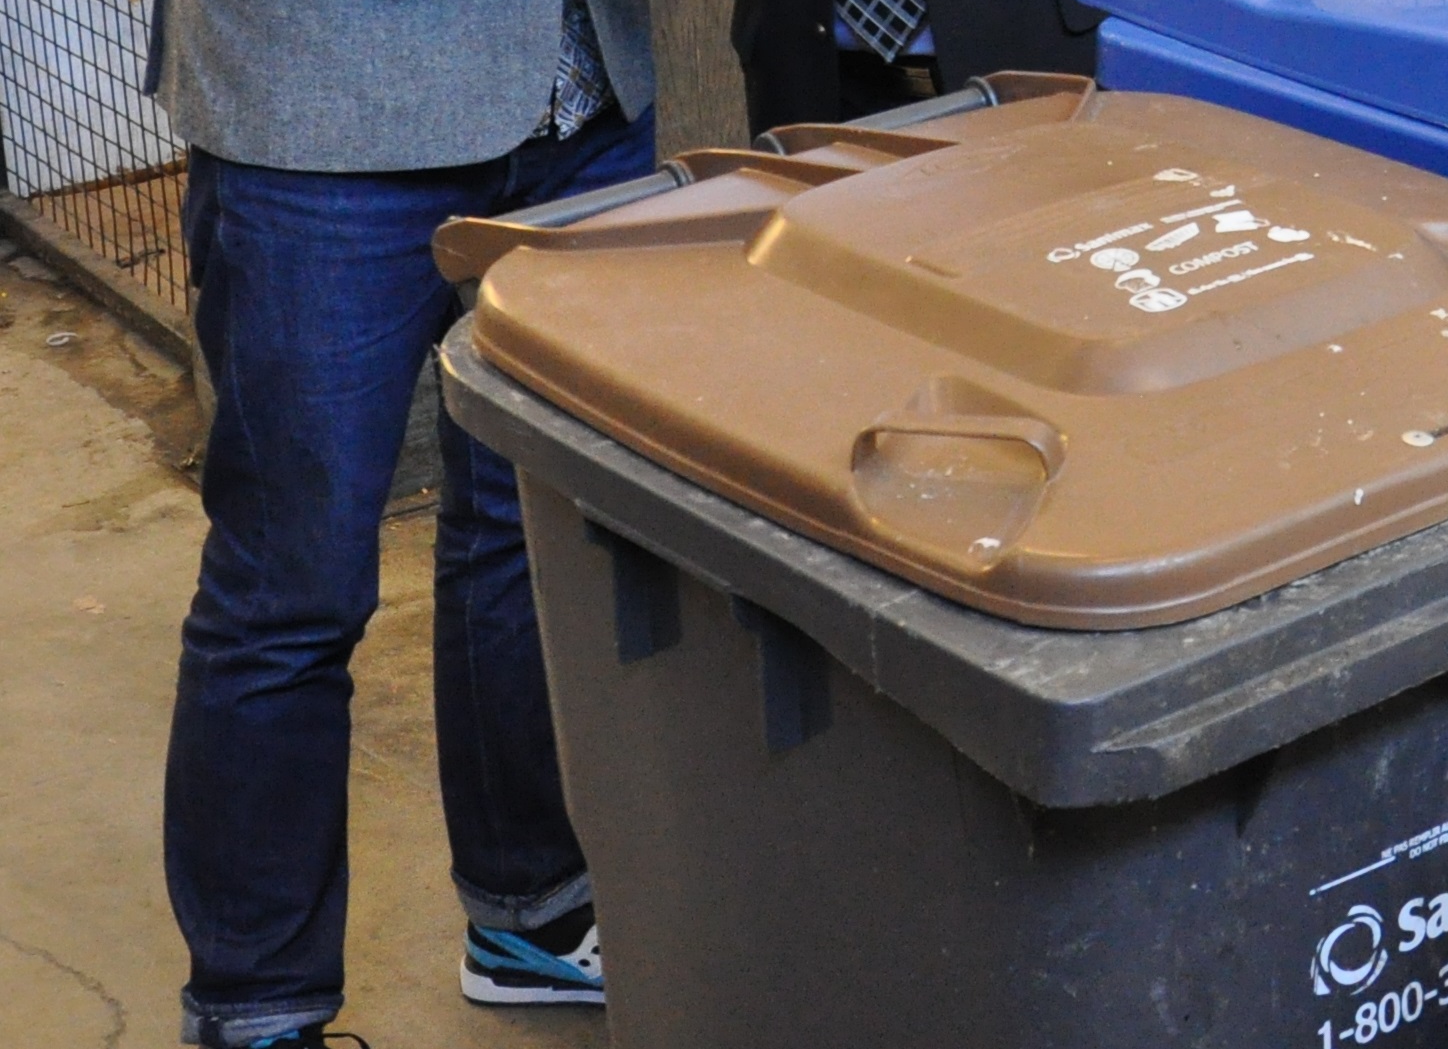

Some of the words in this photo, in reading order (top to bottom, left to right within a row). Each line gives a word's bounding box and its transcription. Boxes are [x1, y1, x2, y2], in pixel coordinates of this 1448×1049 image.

[1168, 241, 1259, 275] COMPOST
[1408, 825, 1441, 848] REMPLIR
[1409, 846, 1422, 859] DO
[1422, 838, 1438, 853] NOT
